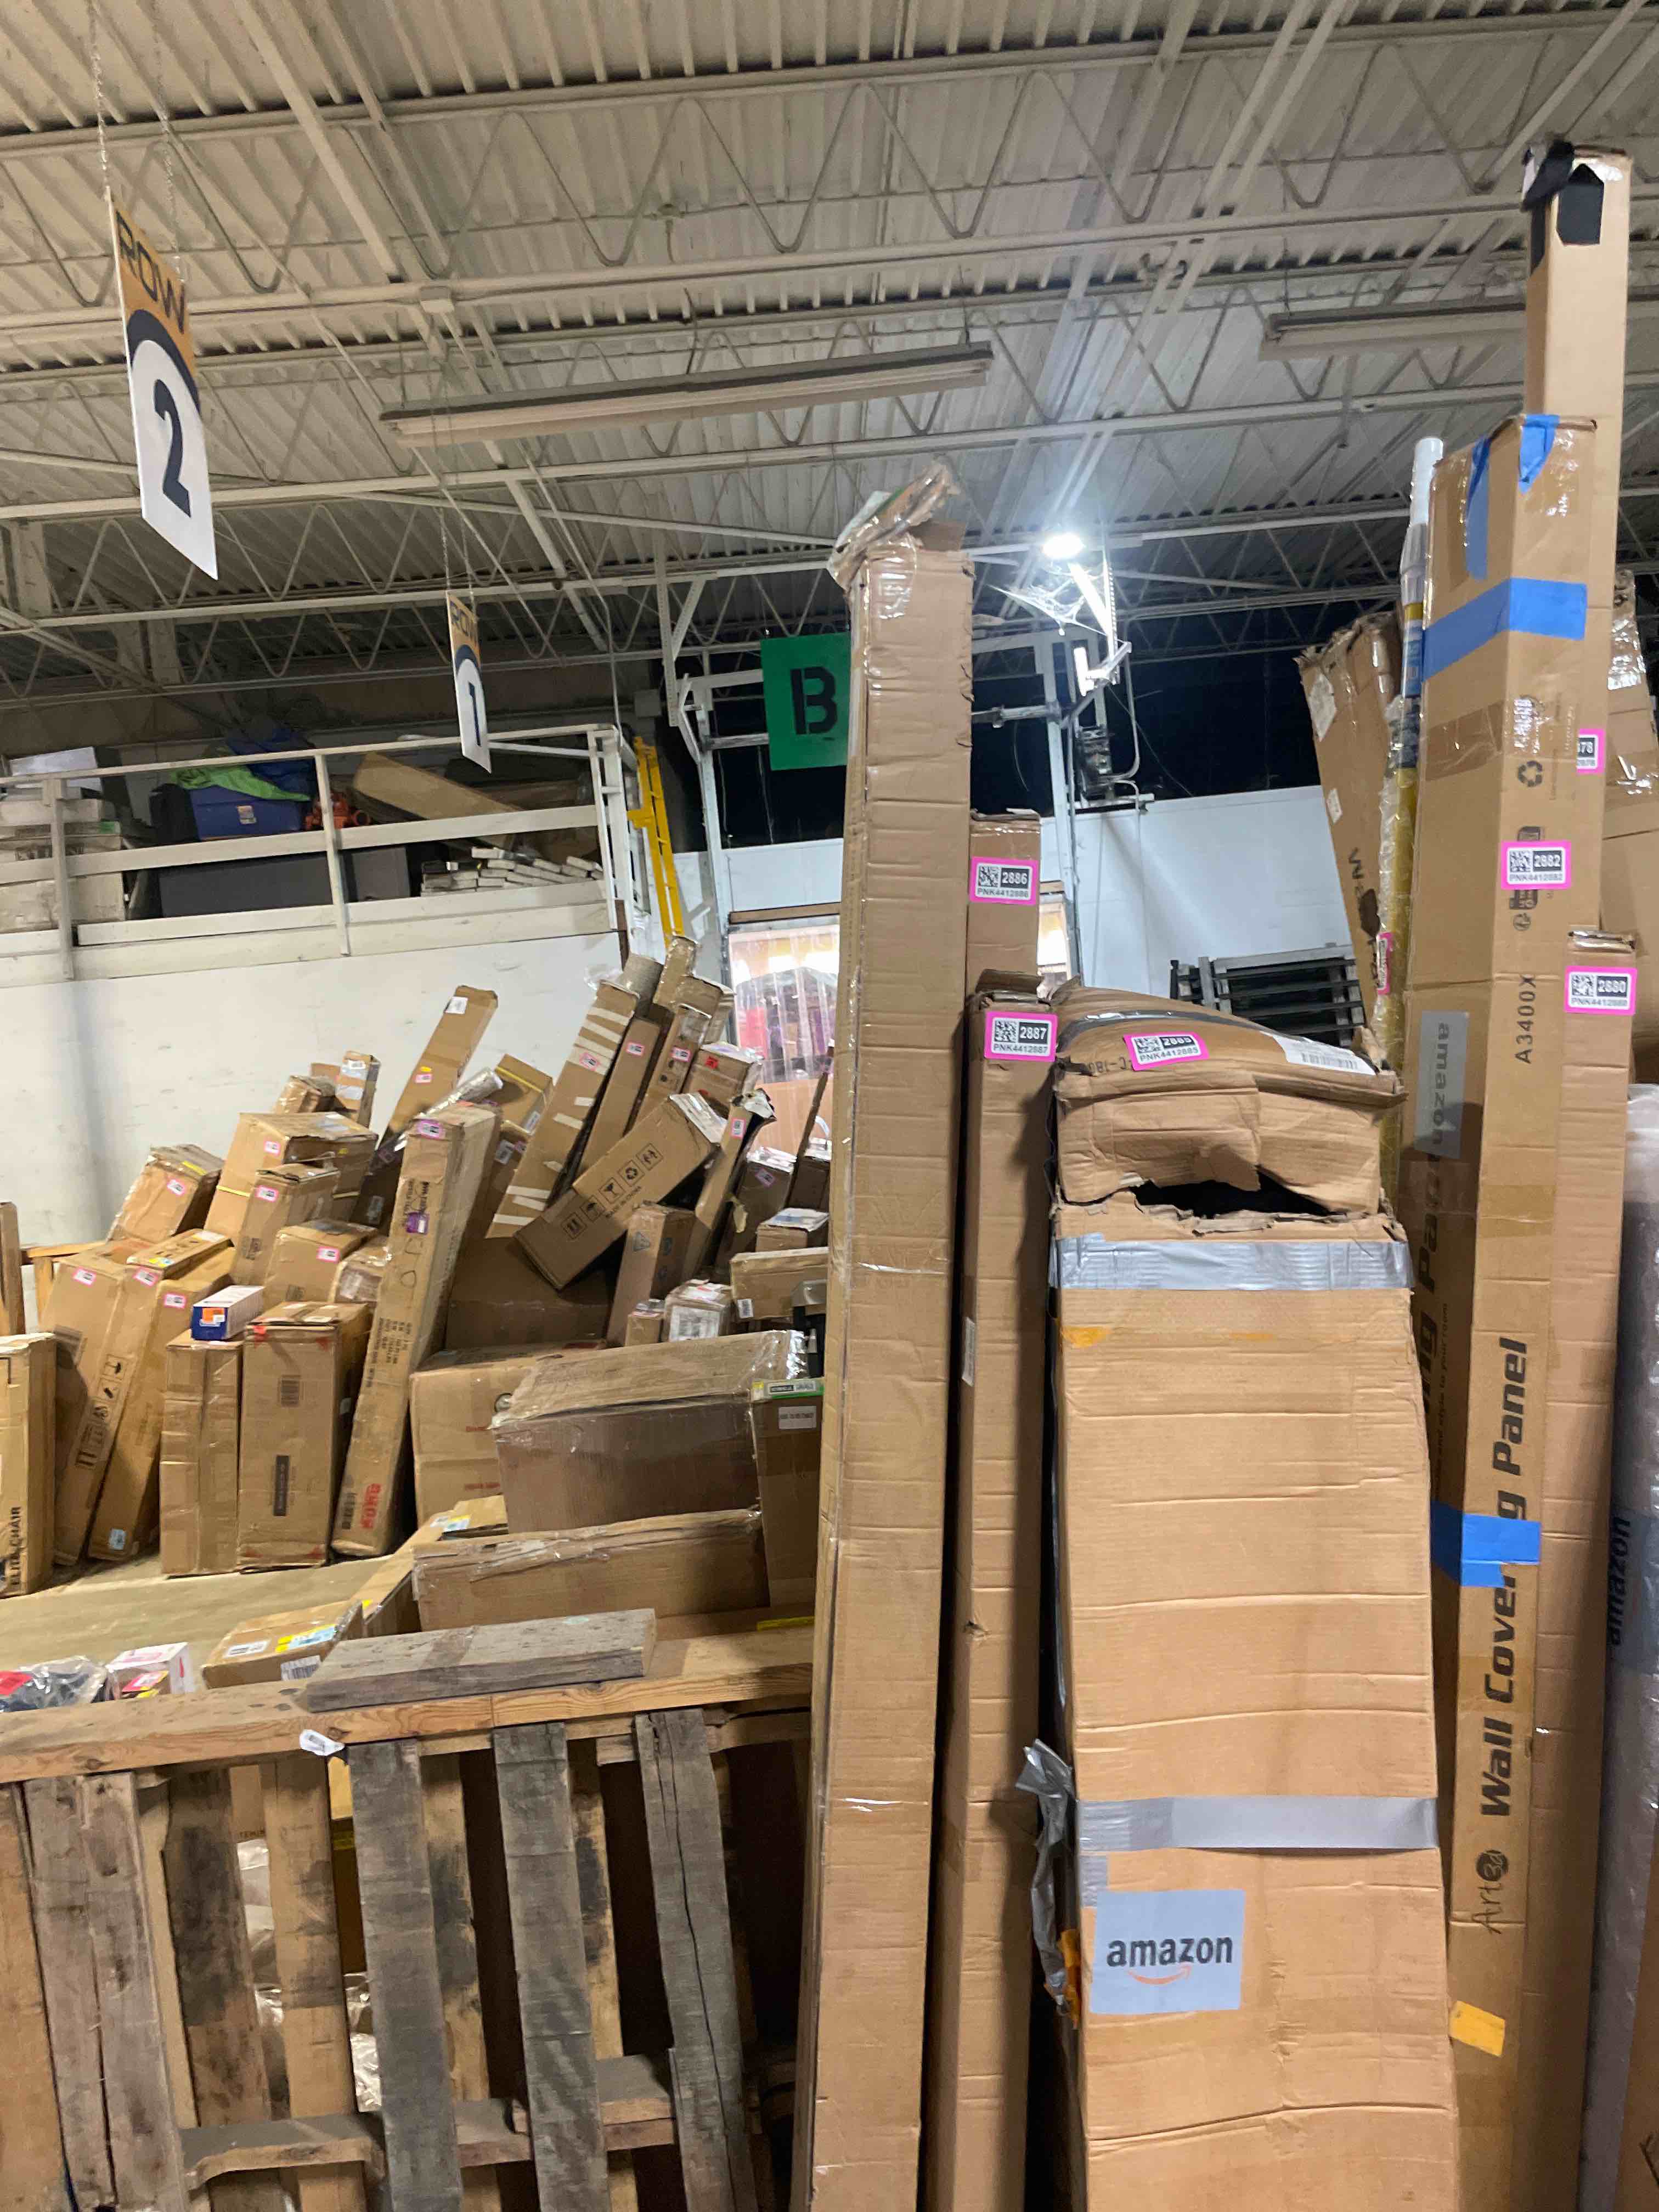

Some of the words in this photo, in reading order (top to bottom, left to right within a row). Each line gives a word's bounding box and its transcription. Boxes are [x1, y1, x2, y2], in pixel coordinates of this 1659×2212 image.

[116, 210, 185, 334] ROW
[154, 379, 191, 517] 2
[449, 600, 479, 646] ROW
[469, 682, 482, 747] 1
[790, 667, 837, 735] B
[1001, 872, 1028, 885] 2886
[993, 1043, 1048, 1053] PNK4412887
[1019, 1026, 1047, 1040] 2887
[1515, 974, 1537, 1064] A3400X
[1139, 1046, 1199, 1063] PNK4412885
[1432, 1022, 1449, 1145] amazon
[1492, 1337, 1528, 1476] Panel
[10, 1507, 21, 1546] CHAIR
[1611, 1517, 1630, 1646] amazon
[1481, 1716, 1513, 1816] Wall
[1107, 1937, 1233, 1970] amazon
